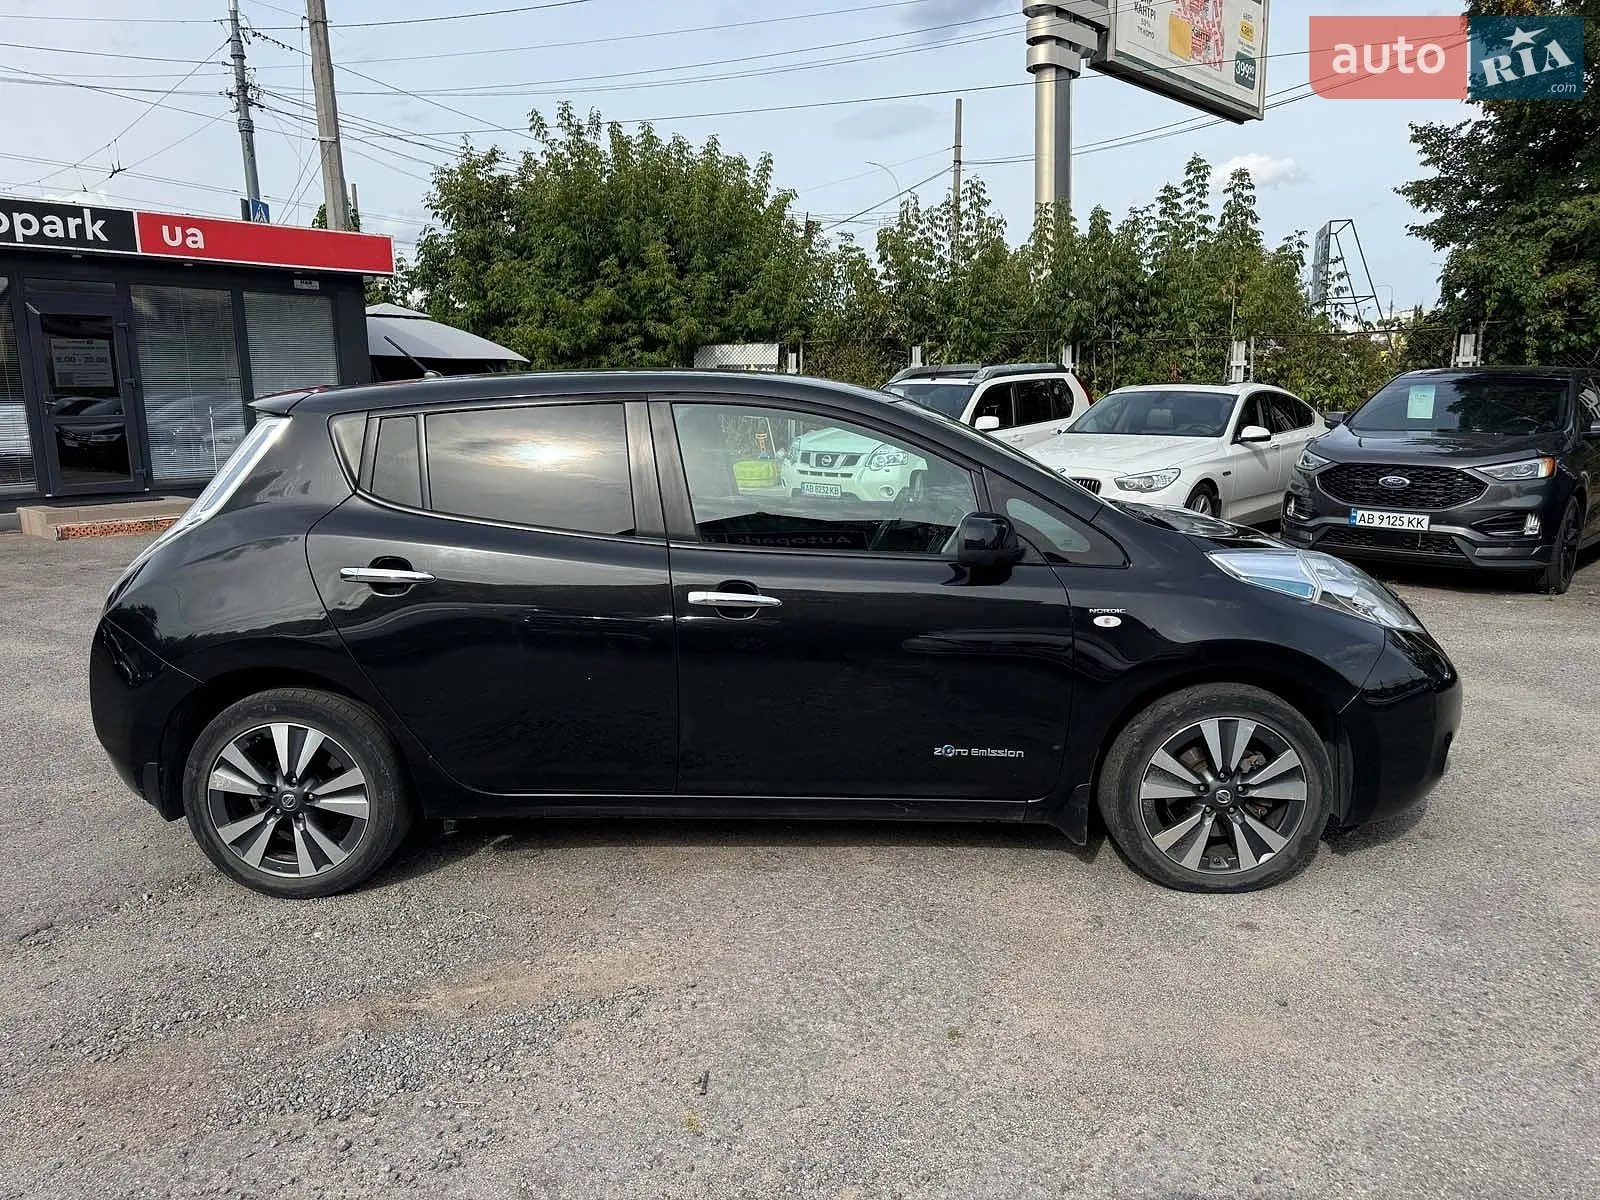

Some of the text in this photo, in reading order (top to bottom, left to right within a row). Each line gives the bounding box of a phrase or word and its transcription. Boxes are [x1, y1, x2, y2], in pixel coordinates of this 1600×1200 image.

[162, 225, 205, 249] ua
[1358, 513, 1426, 529] AB 9125 KK
[970, 747, 1025, 758] Emission
